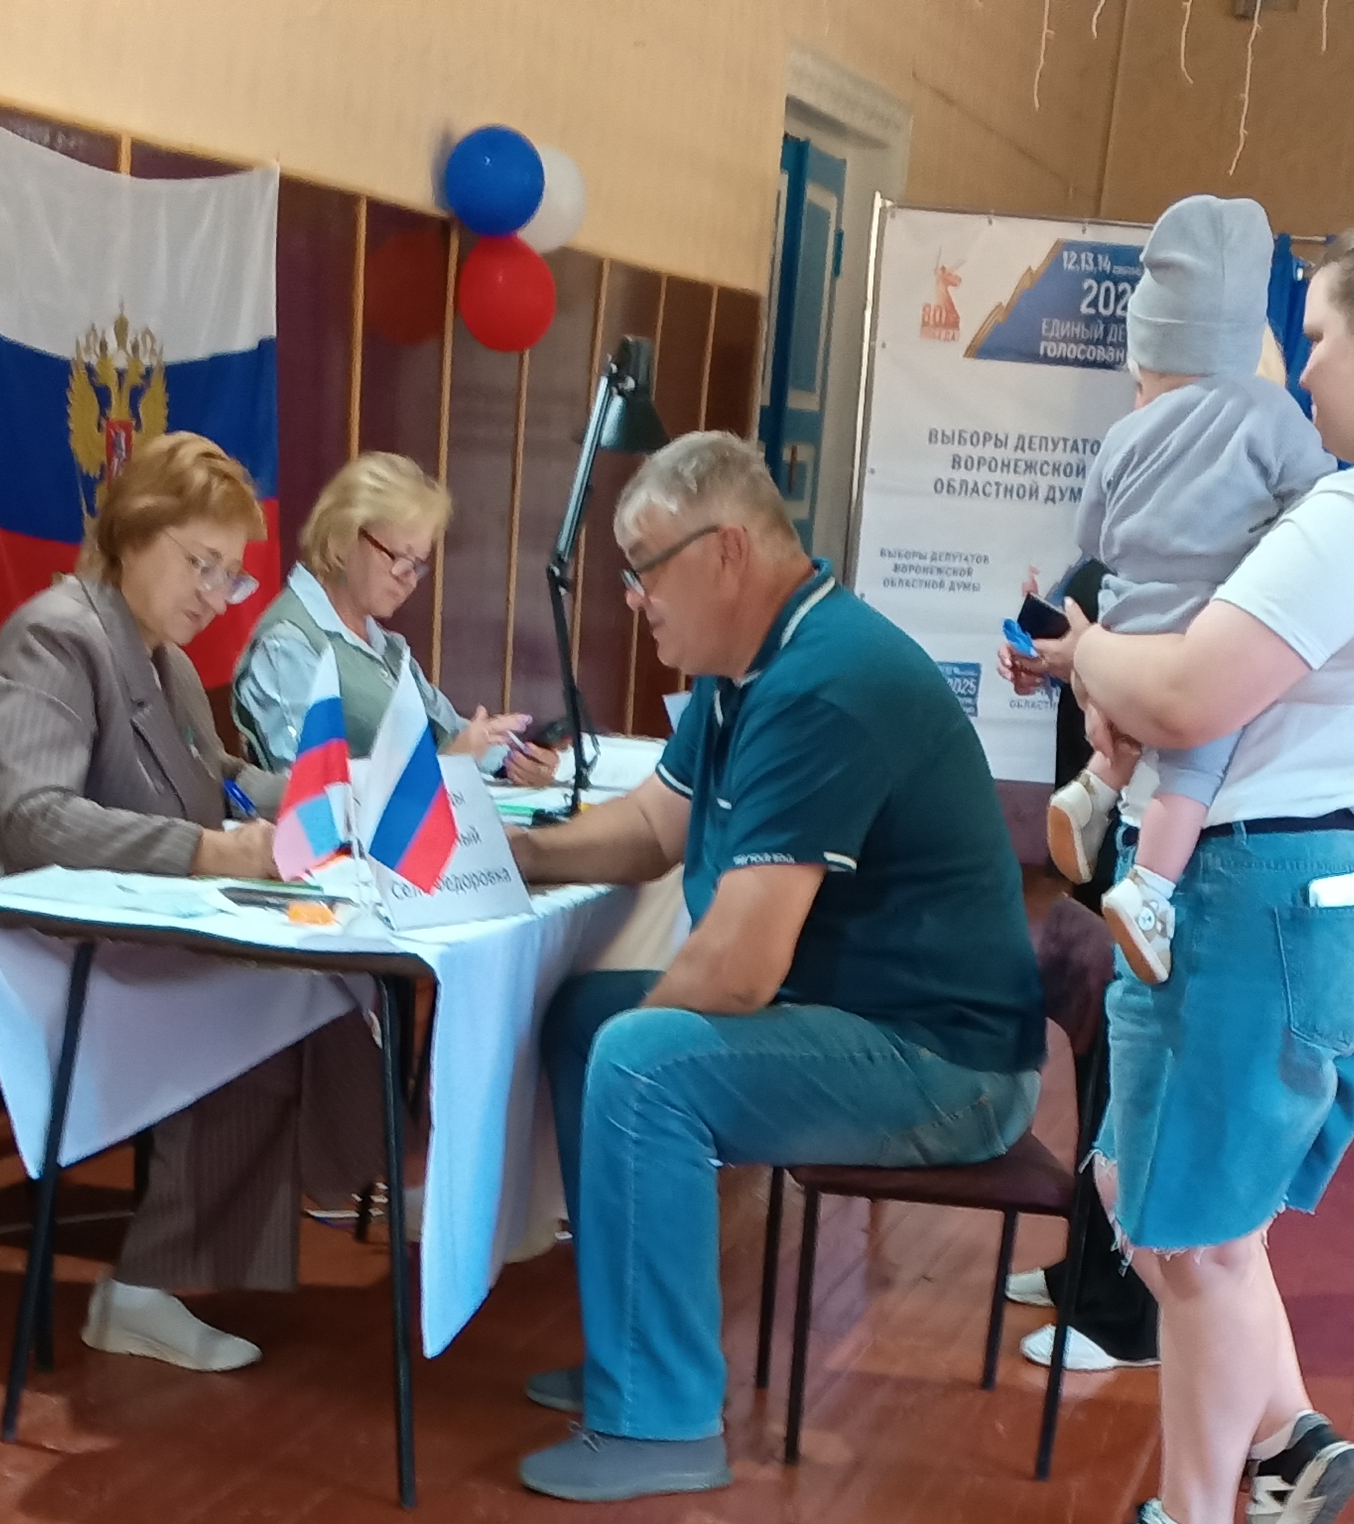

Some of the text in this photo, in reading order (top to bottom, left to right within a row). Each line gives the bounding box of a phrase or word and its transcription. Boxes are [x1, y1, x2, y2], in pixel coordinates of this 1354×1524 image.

[1080, 278, 1137, 317] 202
[1041, 317, 1127, 345] ЕДИНЫЙ ДЕ
[1039, 341, 1127, 363] голосован
[927, 427, 1102, 457] ВЫБОРЫ ДЕПУТАТО
[950, 453, 1087, 479] ВОРОНЕЖСКОЙ
[933, 477, 1083, 505] ОБЛАСТНОЙ ДУМ
